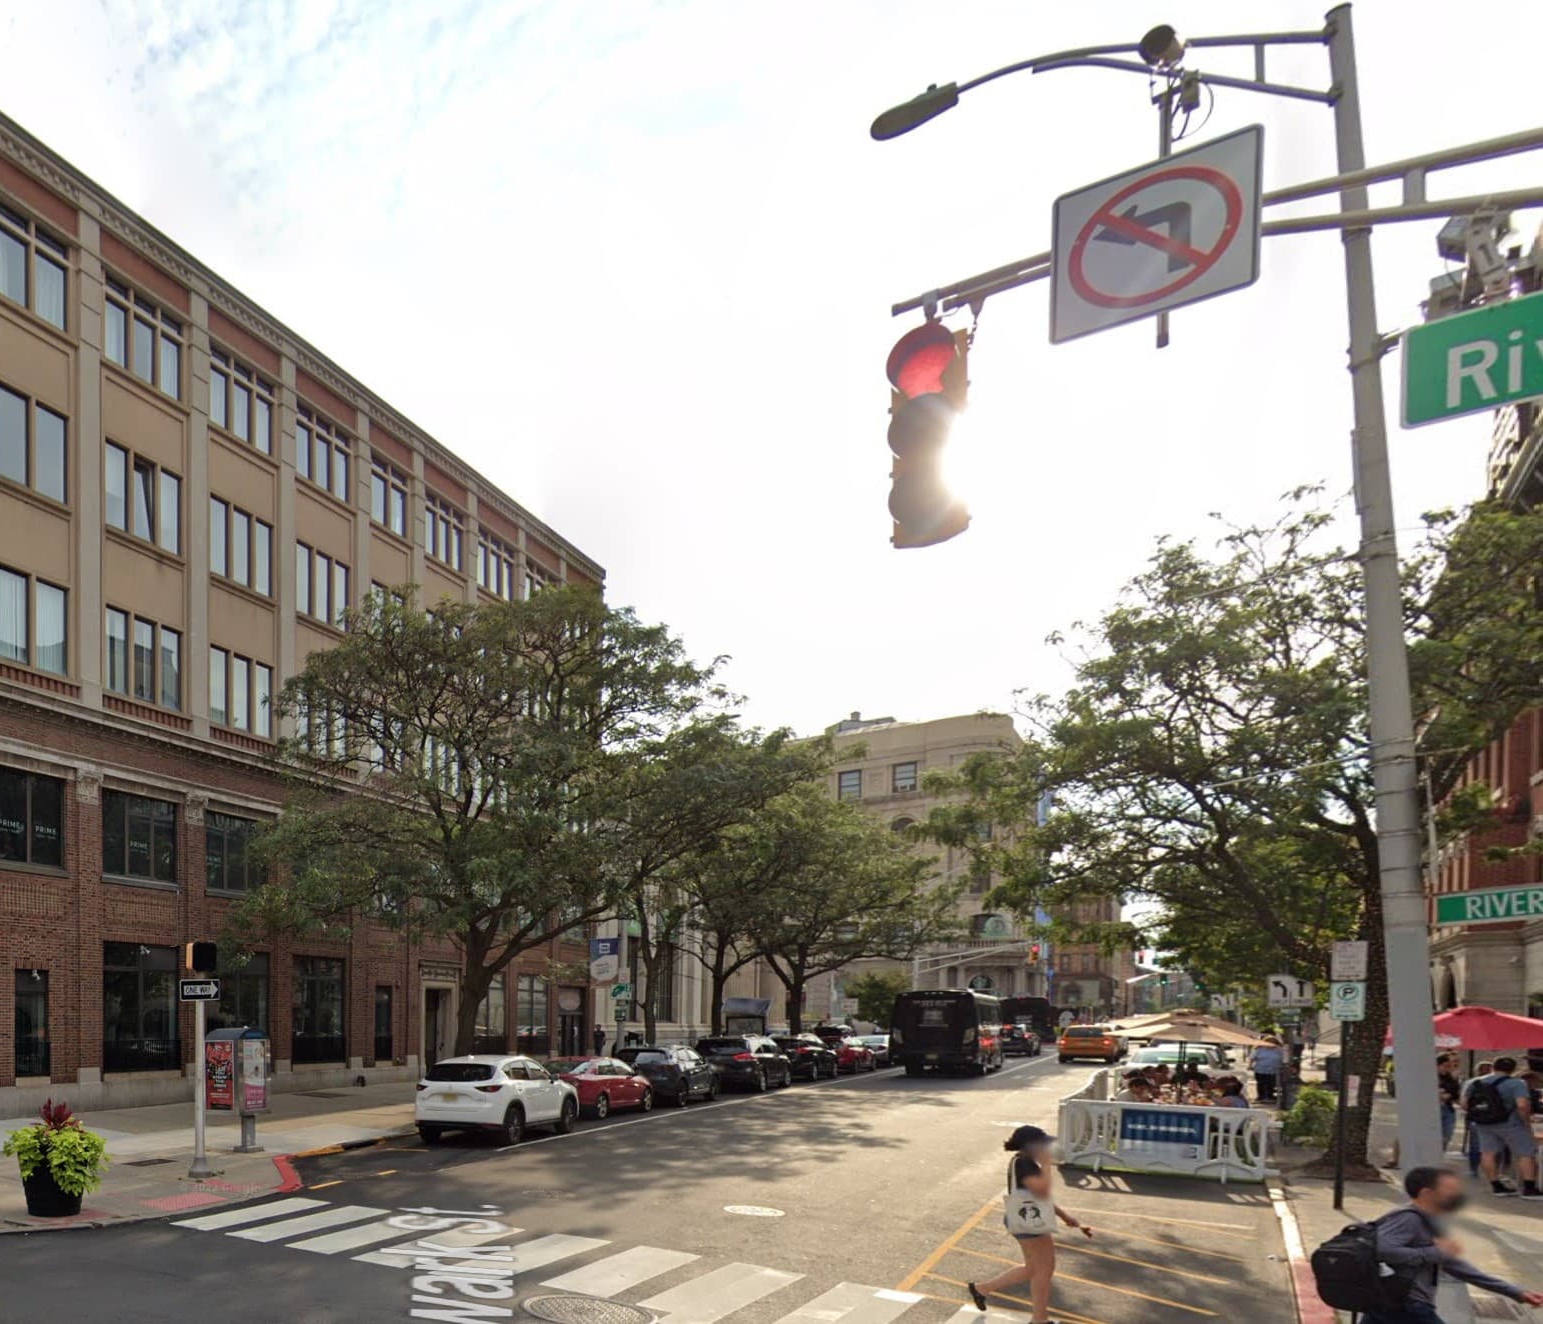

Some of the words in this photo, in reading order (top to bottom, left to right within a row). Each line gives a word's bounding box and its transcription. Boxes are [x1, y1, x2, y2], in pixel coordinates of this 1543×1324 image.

[1446, 329, 1543, 396] Ri
[35, 824, 56, 834] PRIME
[185, 985, 198, 994] ONE
[199, 985, 212, 994] WAY
